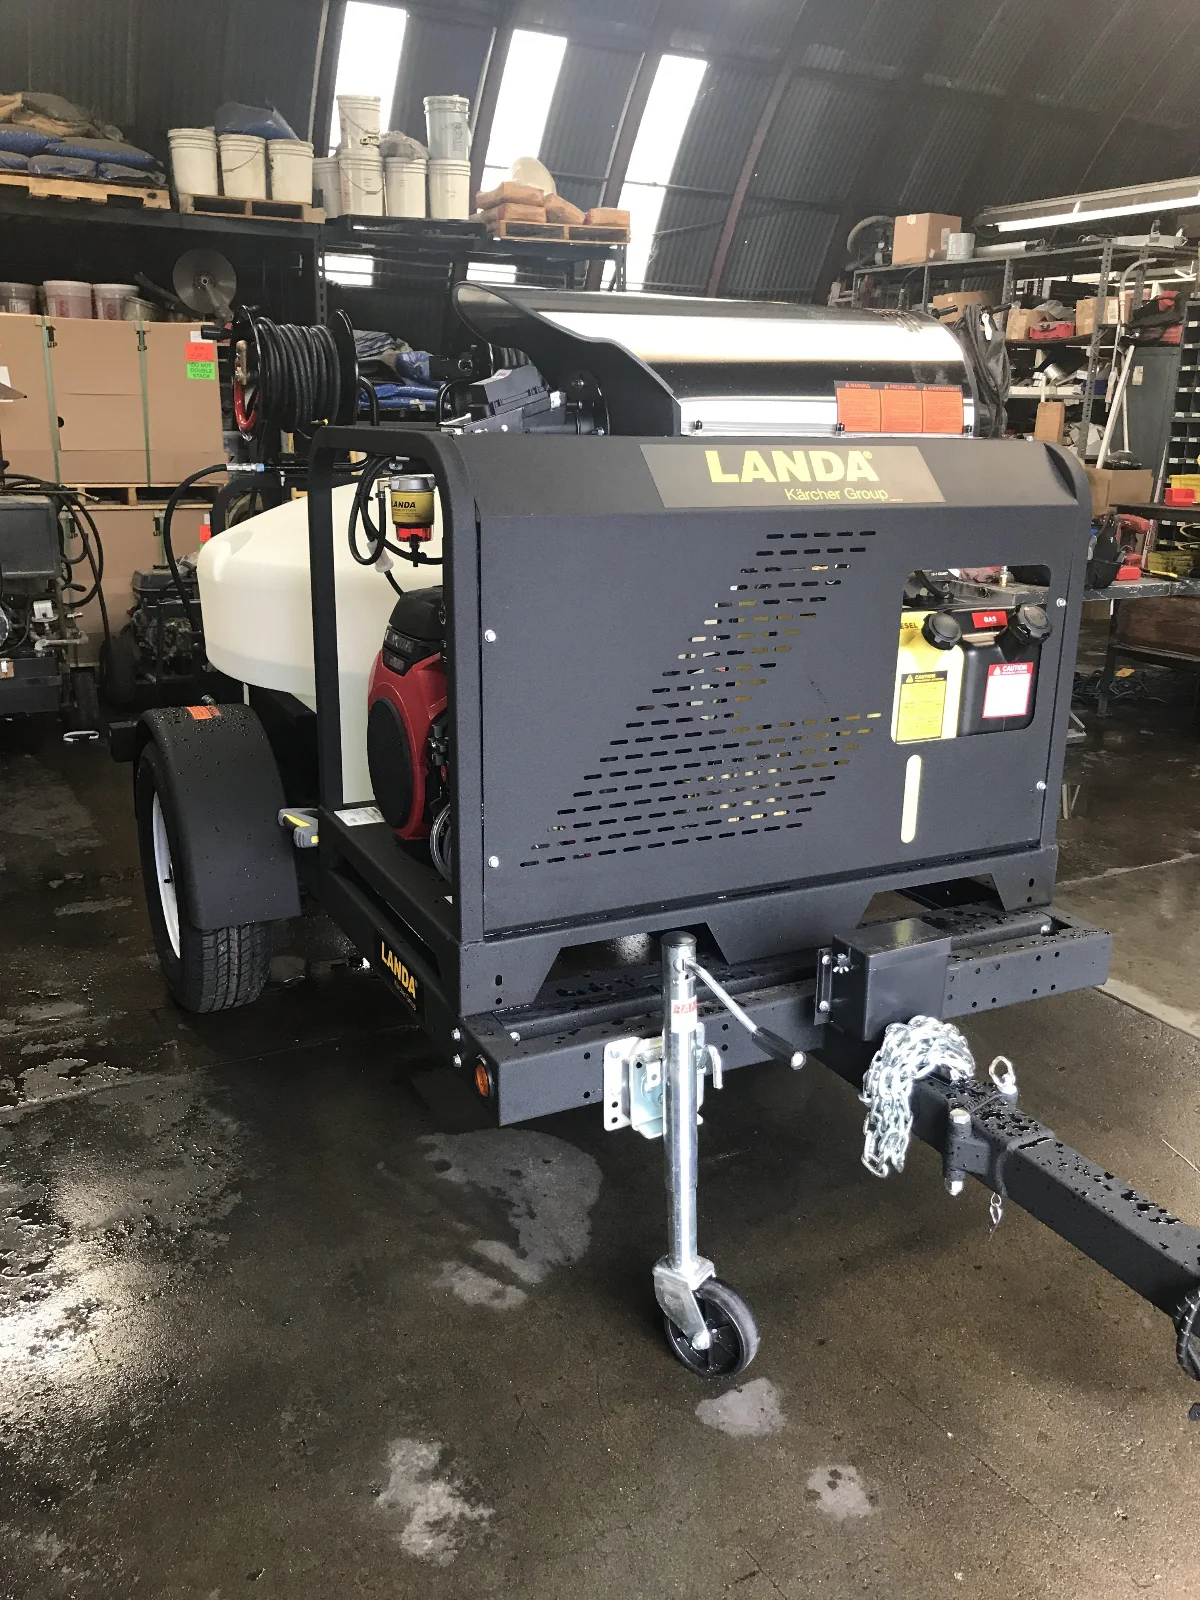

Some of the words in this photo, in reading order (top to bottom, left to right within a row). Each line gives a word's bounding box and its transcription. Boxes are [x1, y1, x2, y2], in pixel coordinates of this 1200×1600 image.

[705, 450, 880, 483] LANDA
[784, 488, 841, 500] Kärcher
[843, 487, 889, 502] Group
[1002, 664, 1028, 672] CAUTION
[381, 940, 417, 999] LANDA
